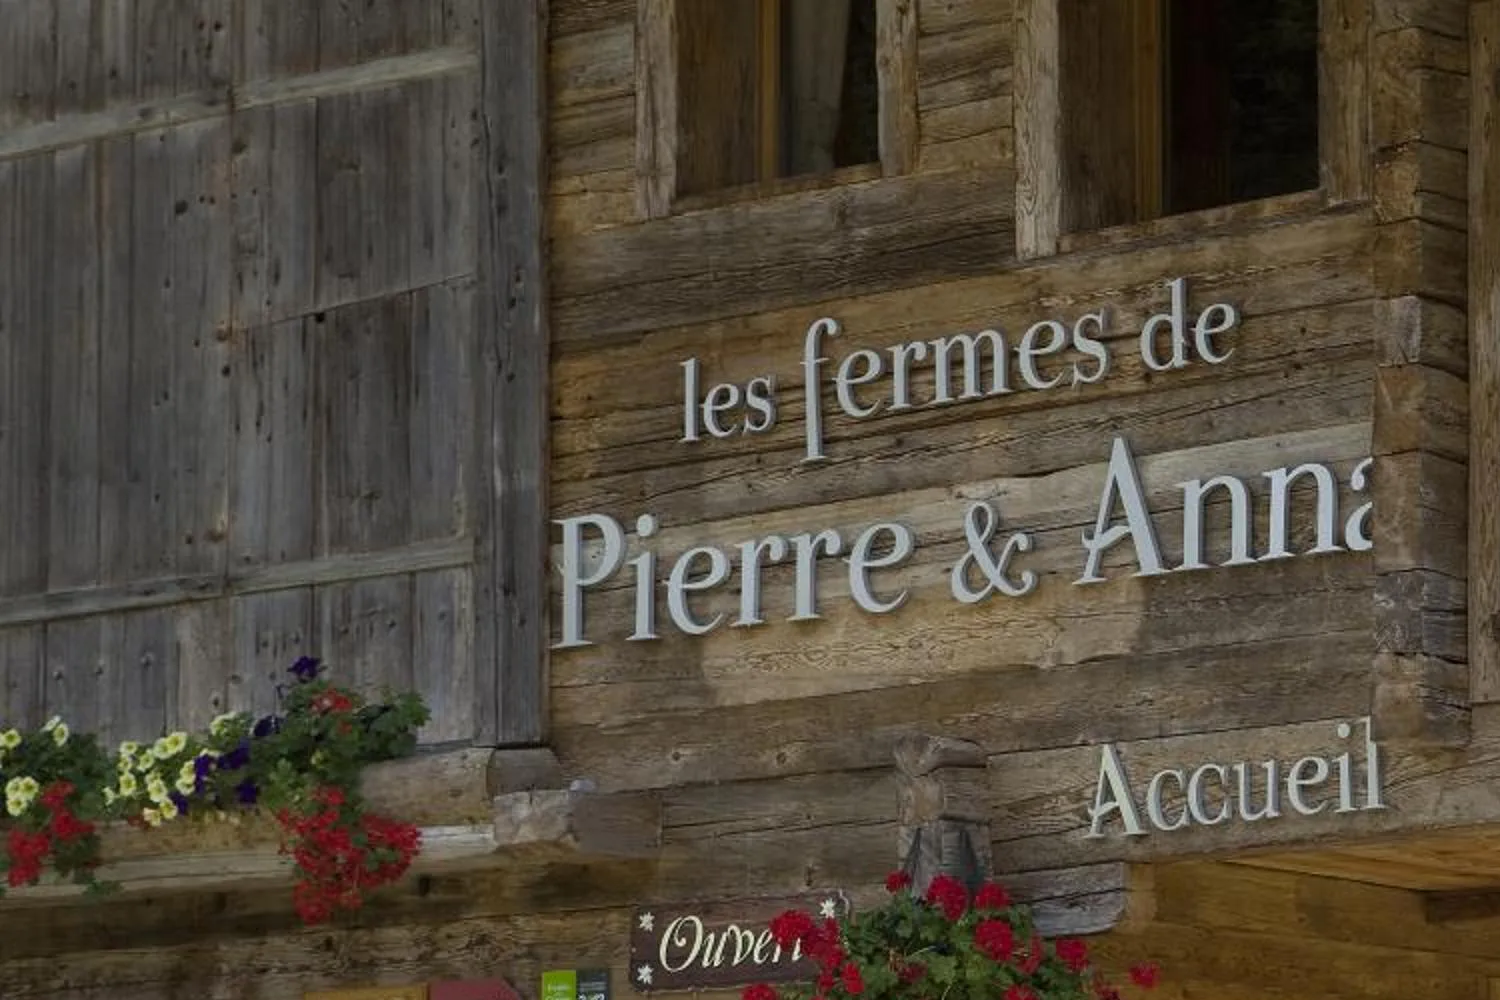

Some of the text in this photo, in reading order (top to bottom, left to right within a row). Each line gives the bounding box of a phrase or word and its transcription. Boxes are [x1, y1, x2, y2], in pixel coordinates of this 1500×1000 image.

[679, 276, 1239, 461] les fermes de
[551, 512, 916, 650] Pierre
[951, 500, 1040, 605] &
[1083, 715, 1388, 840] Accueil
